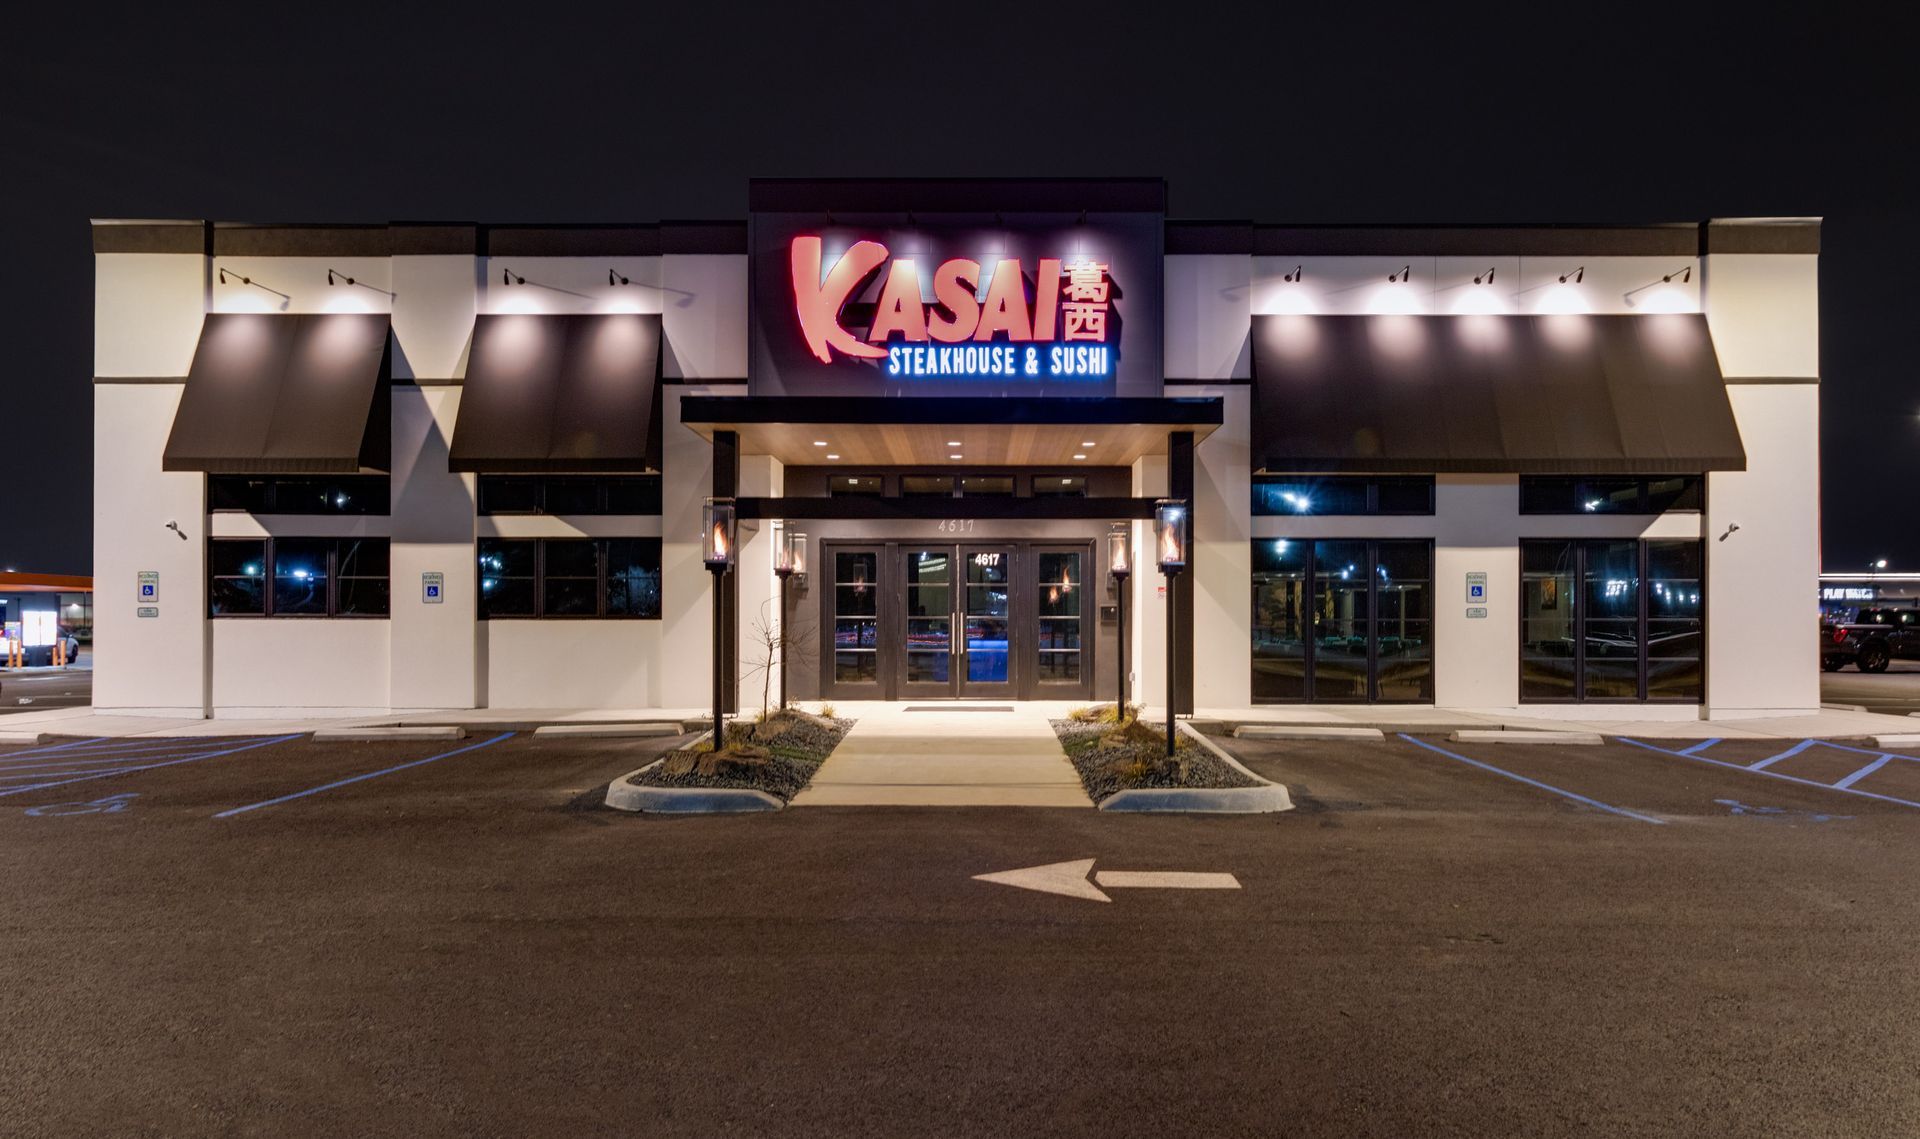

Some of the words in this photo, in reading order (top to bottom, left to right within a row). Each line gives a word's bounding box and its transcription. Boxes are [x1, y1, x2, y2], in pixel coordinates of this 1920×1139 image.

[791, 236, 1061, 364] KASAI
[1063, 258, 1108, 341] 葛西
[889, 346, 1015, 374] STEAKHOUSE
[1025, 346, 1038, 374] &
[1051, 346, 1108, 374] SUSHI
[939, 520, 975, 532] 4617
[975, 553, 999, 566] 4617
